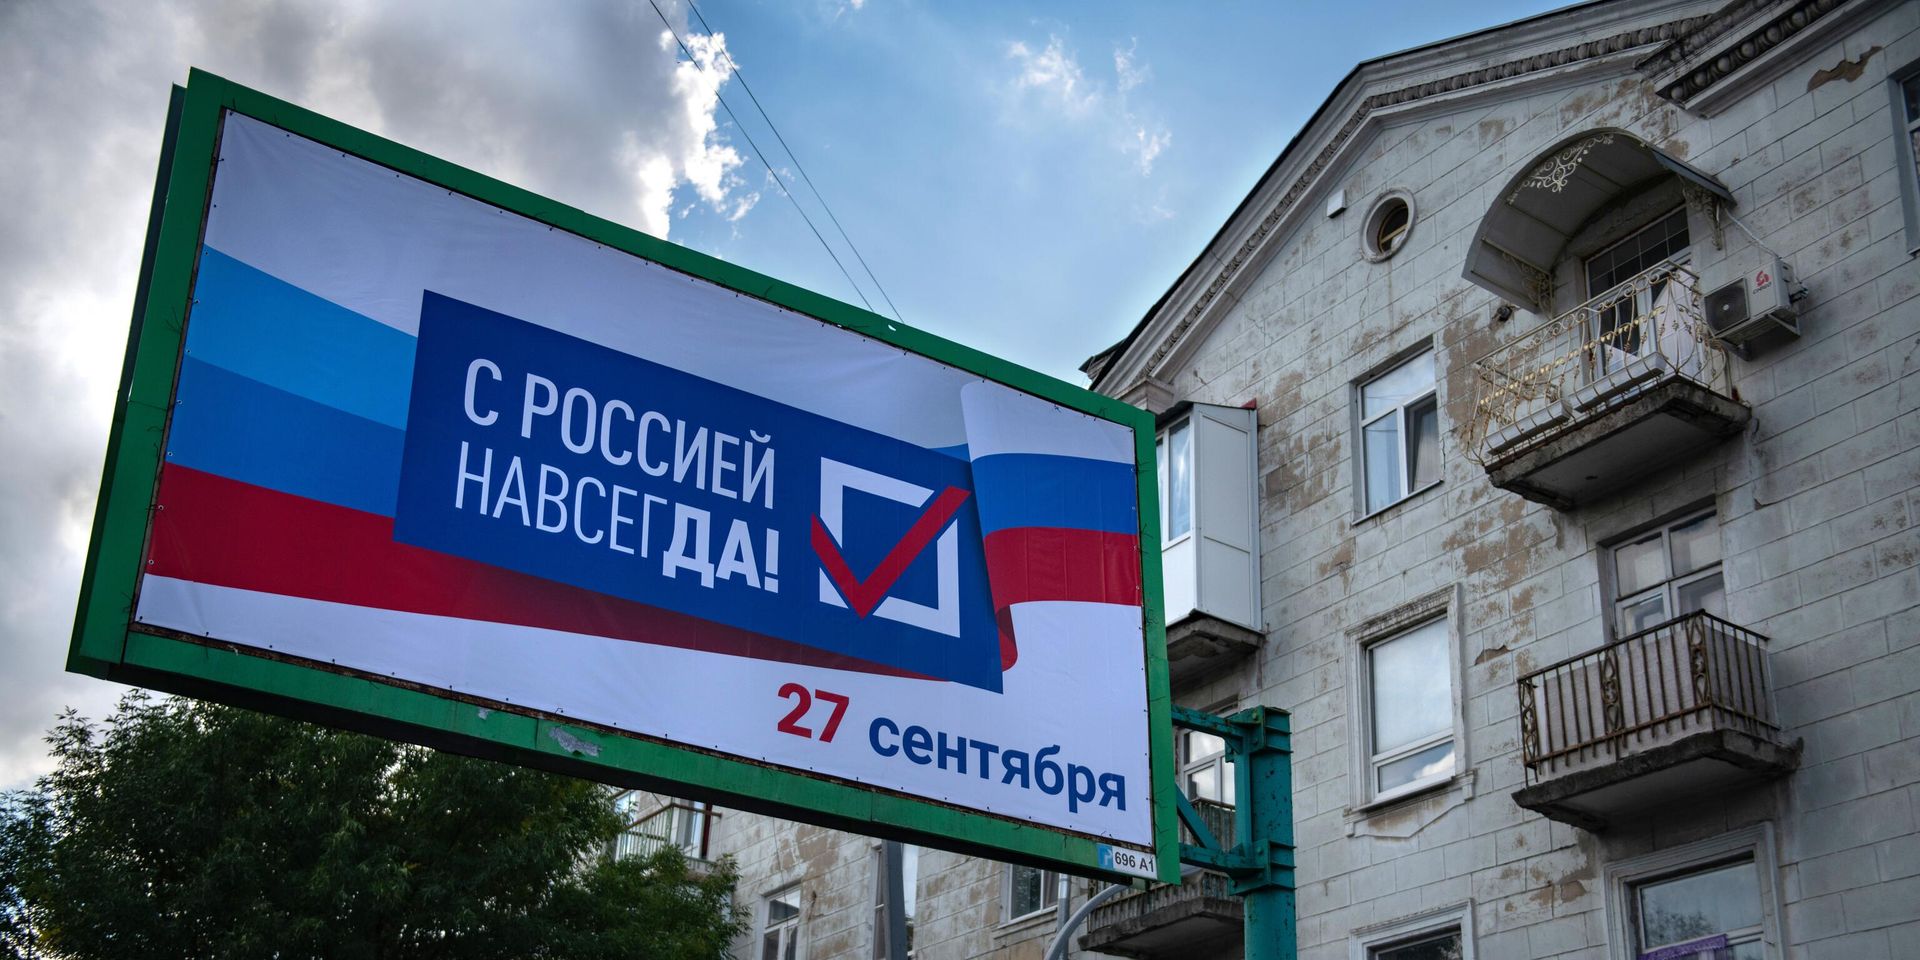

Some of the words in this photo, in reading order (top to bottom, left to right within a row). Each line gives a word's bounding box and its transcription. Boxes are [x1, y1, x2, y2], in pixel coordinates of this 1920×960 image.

[464, 358, 502, 426] С
[521, 373, 775, 509] РОССИЕЙ
[455, 440, 779, 594] НАВСЕГДА!
[777, 682, 849, 744] 27
[868, 716, 1127, 814] сентября
[1114, 851, 1136, 868] 696
